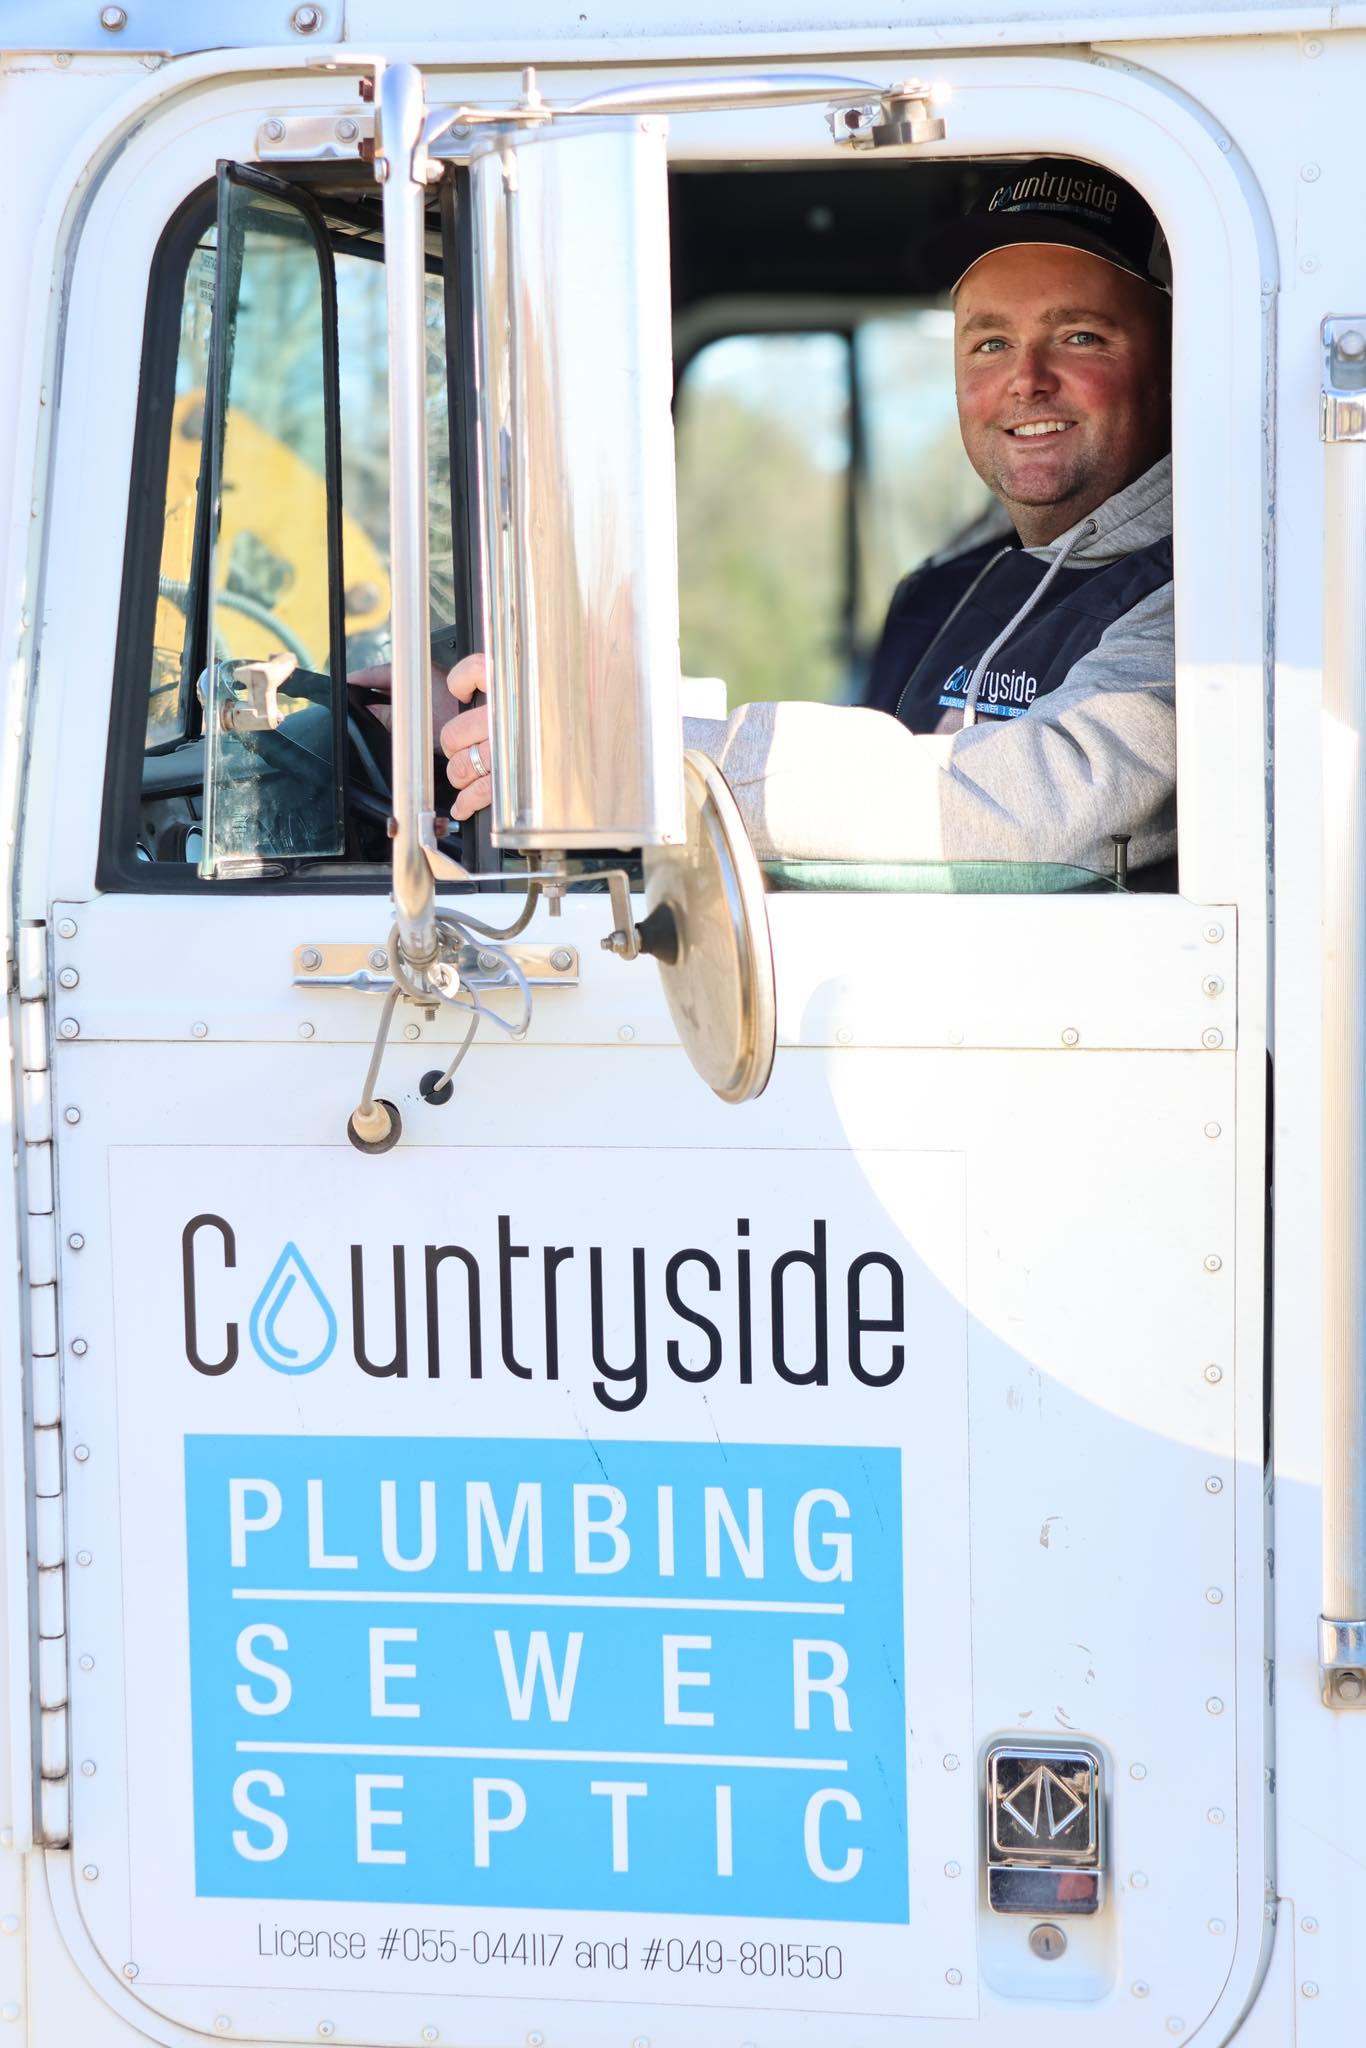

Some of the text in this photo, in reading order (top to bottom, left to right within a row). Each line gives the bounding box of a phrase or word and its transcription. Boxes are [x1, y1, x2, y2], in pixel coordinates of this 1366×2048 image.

[976, 703, 999, 715] SEWER
[229, 1478, 853, 1583] PLUMBING
[235, 1623, 853, 1732] SEWER
[232, 1769, 863, 1882] SEPTIC
[258, 1923, 843, 1980] License #055-044117 and #049-801550
